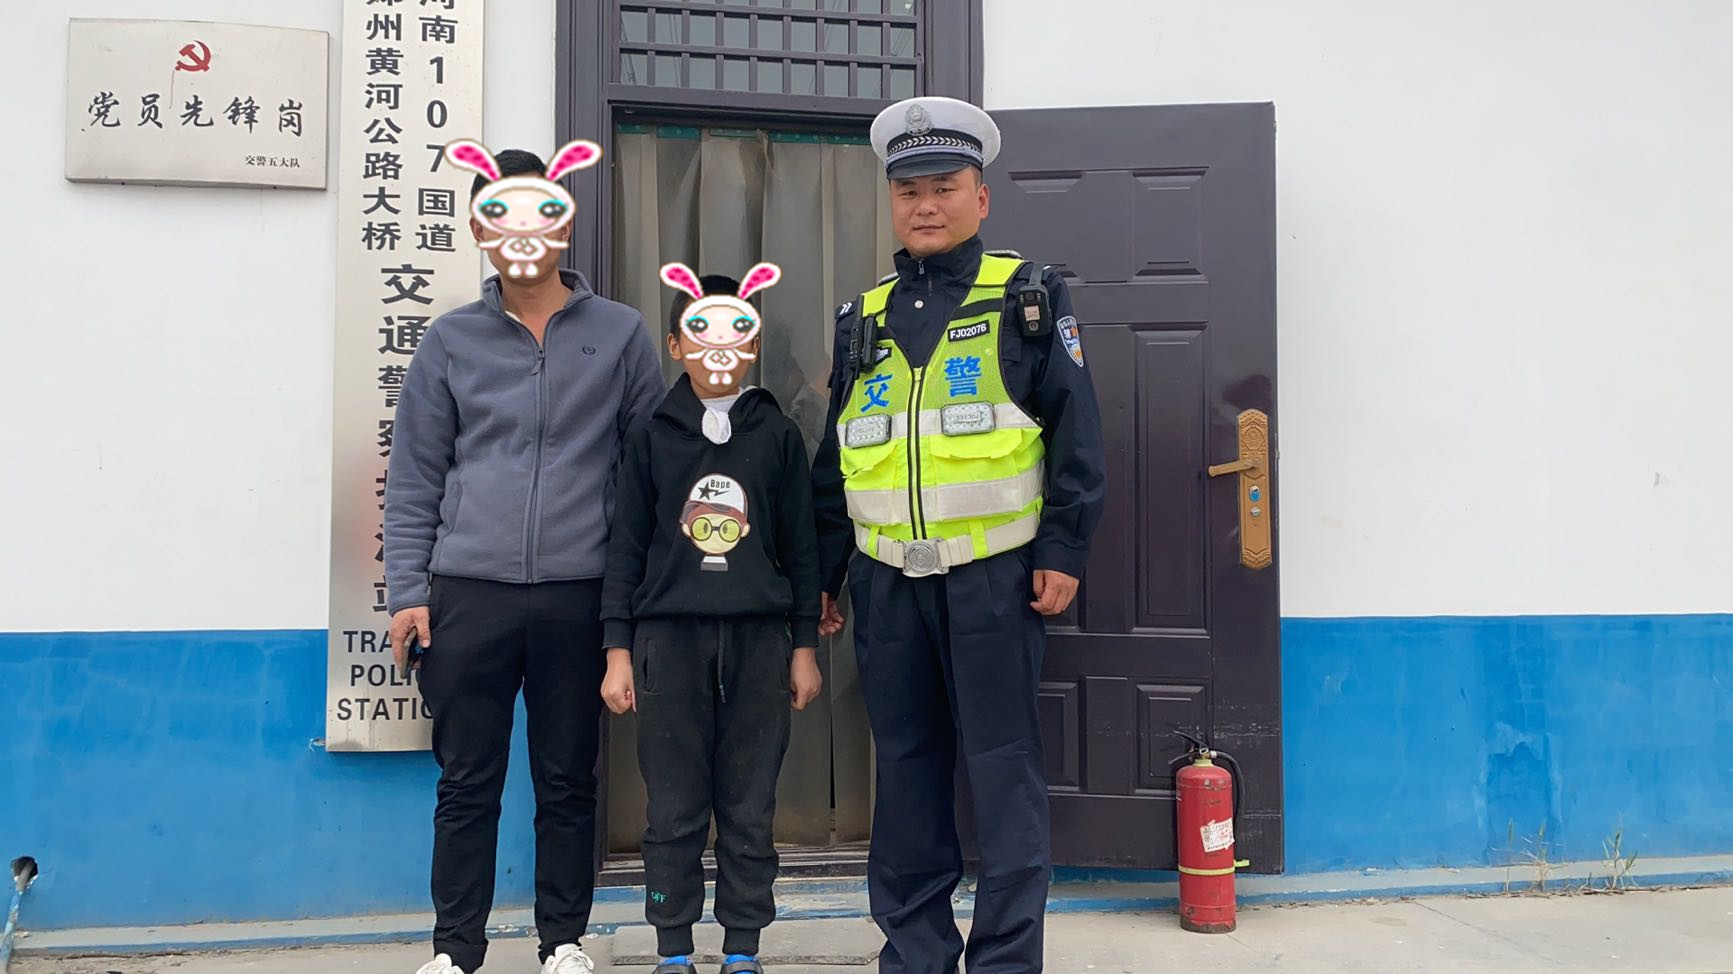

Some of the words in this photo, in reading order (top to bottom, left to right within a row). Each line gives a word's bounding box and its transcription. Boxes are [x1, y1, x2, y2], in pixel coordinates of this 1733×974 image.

[87, 91, 303, 137] 党员先锋岗
[361, 0, 404, 251] 州黄河公路大桥
[244, 155, 301, 168] 交警五大队
[950, 323, 987, 340] FJ02076
[350, 663, 413, 687] POLI
[336, 697, 434, 721] STATIO
